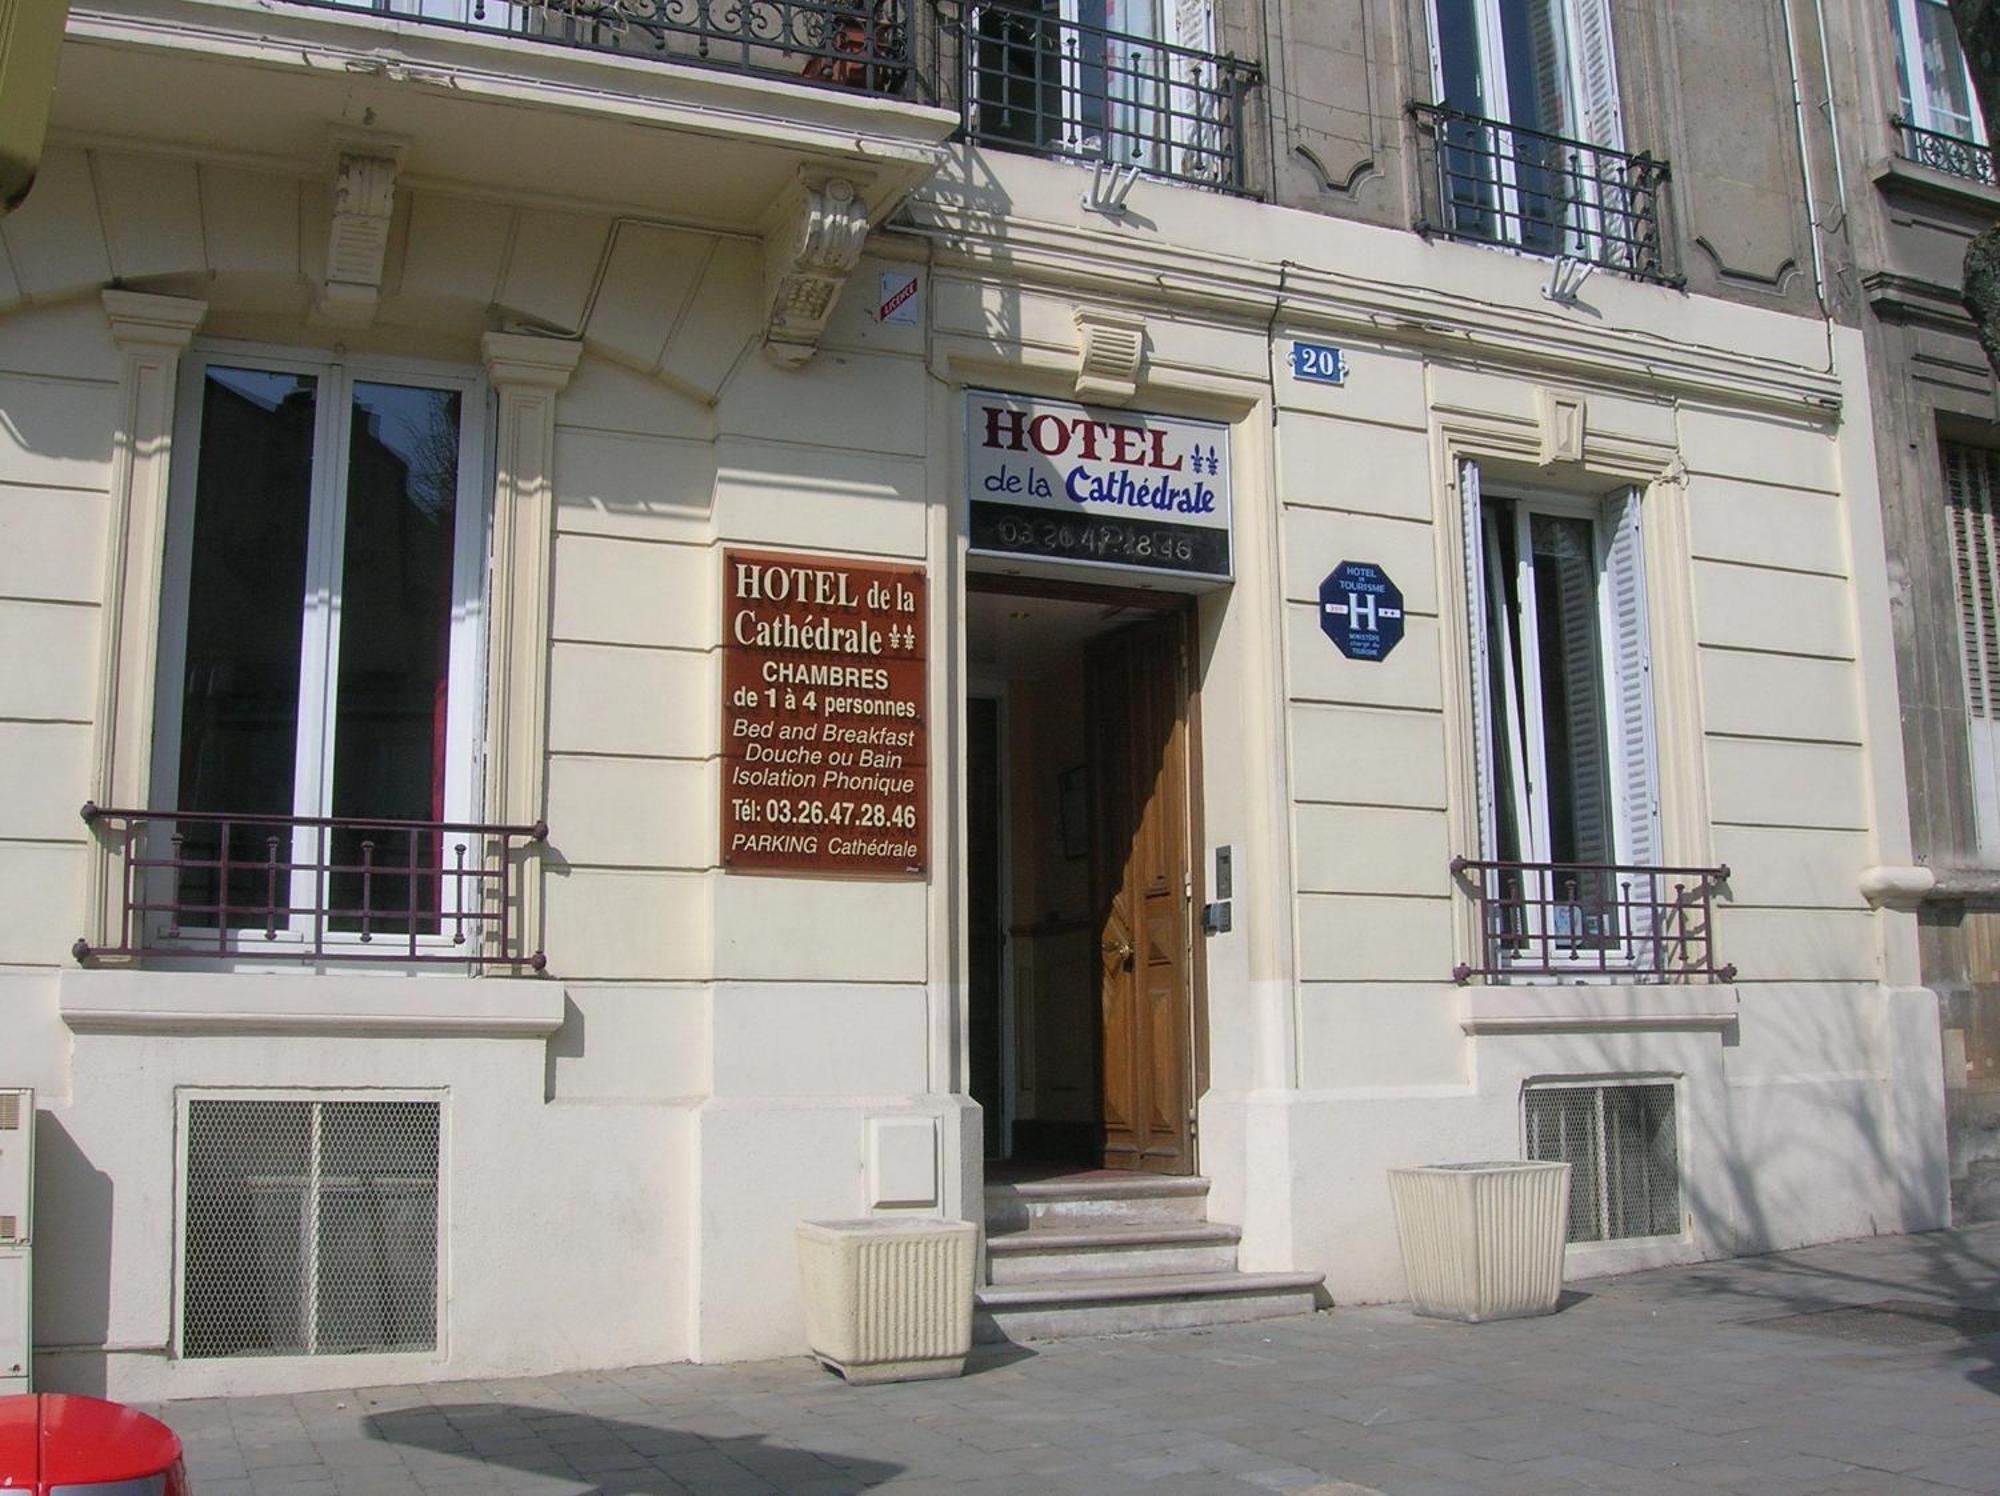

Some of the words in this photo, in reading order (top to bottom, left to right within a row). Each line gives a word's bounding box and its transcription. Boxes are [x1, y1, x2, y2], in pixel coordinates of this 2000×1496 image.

[1302, 348, 1334, 376] 20
[982, 406, 1184, 472] HOTEL
[984, 464, 1021, 493] de
[1027, 467, 1052, 498] la
[1065, 464, 1216, 515] Cathédrale
[1340, 581, 1386, 592] TOURISME
[1347, 567, 1377, 577] HOTEL
[735, 563, 859, 609] HOTEL
[866, 580, 890, 610] de
[896, 583, 915, 613] la
[1348, 592, 1378, 632] H
[734, 609, 883, 655] Cathédrale
[762, 661, 889, 690] CHAMBRES
[733, 685, 758, 708] de
[764, 688, 777, 709] 1
[784, 688, 797, 710] à
[802, 690, 817, 711] 4
[824, 694, 916, 719] personnes
[733, 719, 773, 739] Bed
[778, 722, 817, 742] and
[822, 723, 915, 748] Breakfast
[745, 743, 822, 766] Douche
[828, 751, 853, 767] ou
[859, 748, 903, 769] Bain
[732, 767, 816, 789] Isolation
[822, 770, 915, 797] Phonique
[732, 798, 762, 823] Tél:
[765, 798, 917, 829] 03.26.47.28.46
[731, 834, 818, 855] PARKING
[827, 836, 918, 858] Cathédrale
